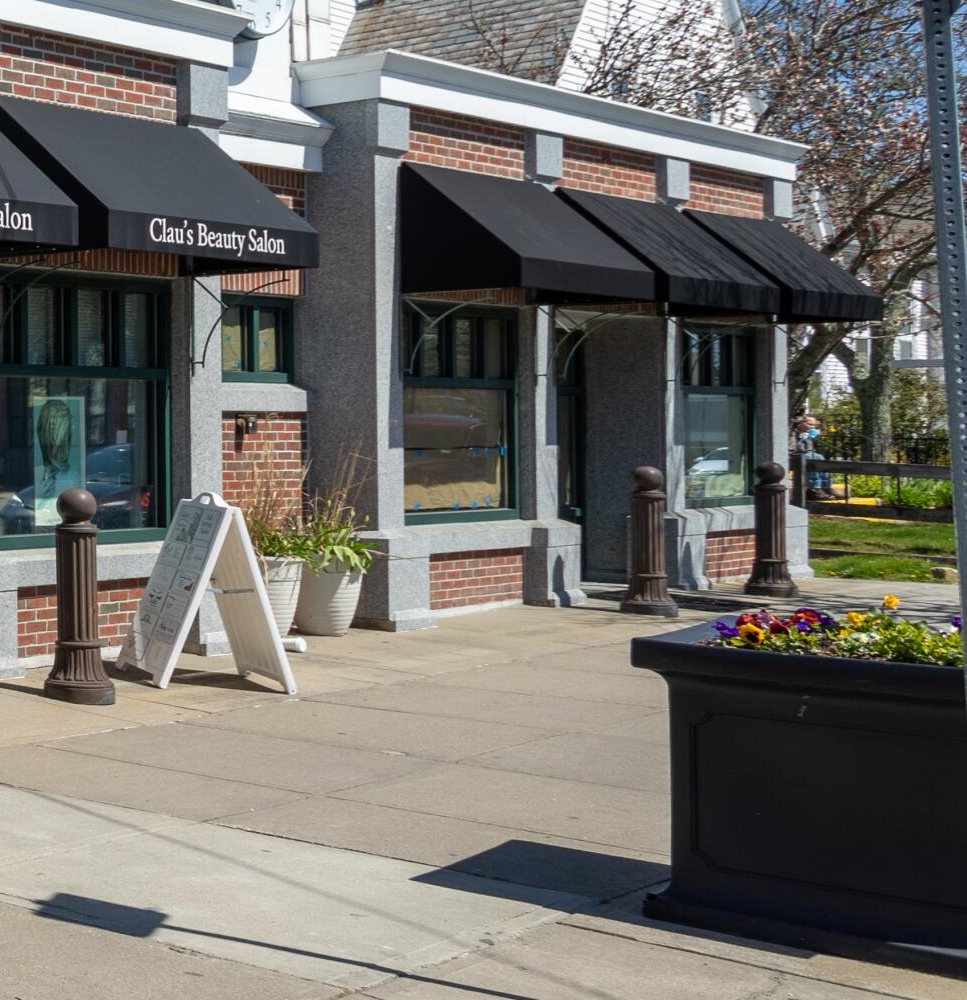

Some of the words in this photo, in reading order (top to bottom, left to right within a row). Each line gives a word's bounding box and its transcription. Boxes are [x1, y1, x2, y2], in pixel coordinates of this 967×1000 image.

[265, 12, 271, 28] 5
[149, 217, 194, 246] Clau's
[197, 222, 246, 257] Beauty
[248, 228, 286, 255] Salon
